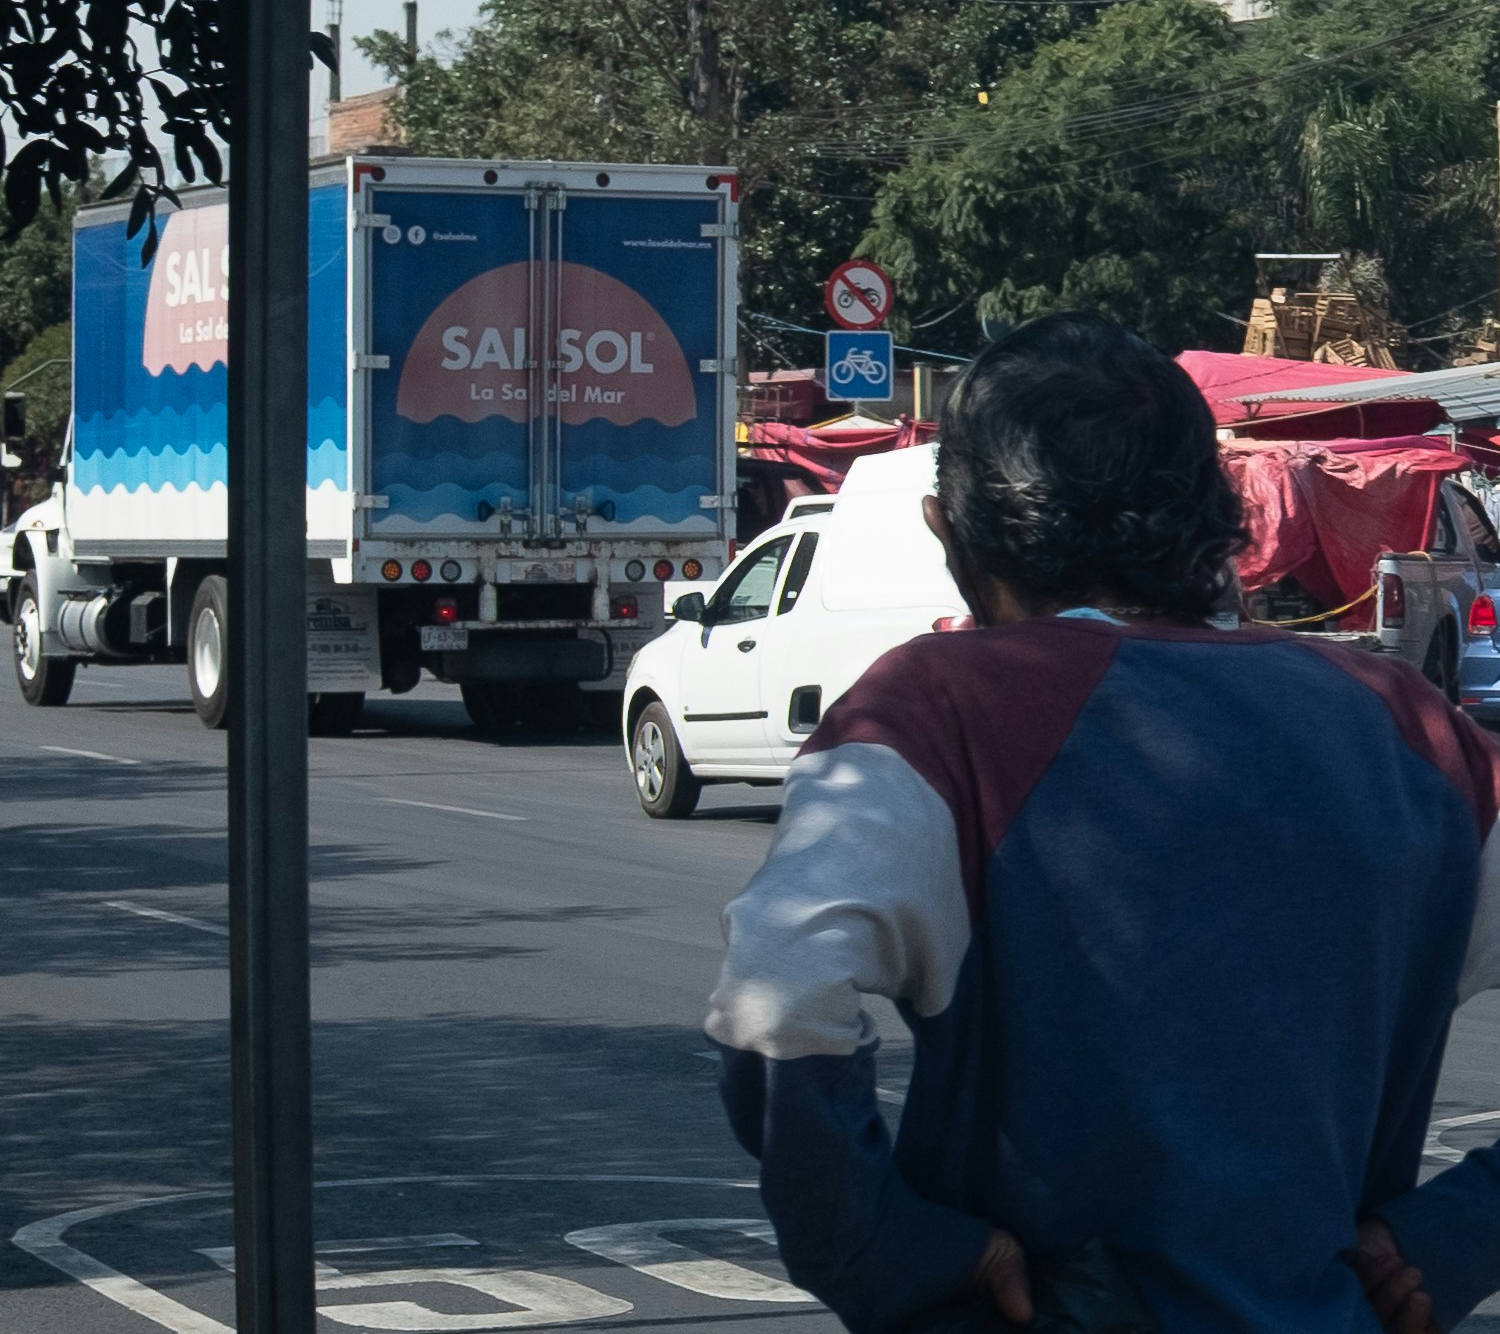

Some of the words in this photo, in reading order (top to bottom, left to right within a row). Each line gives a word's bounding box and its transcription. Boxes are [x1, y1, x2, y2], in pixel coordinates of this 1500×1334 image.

[164, 248, 216, 308] SAL
[179, 322, 194, 344] La
[196, 316, 214, 342] Sal
[557, 328, 655, 375] SOL
[470, 383, 494, 402] La
[501, 384, 528, 402] Sa
[547, 383, 577, 403] del
[583, 385, 626, 405] Mar
